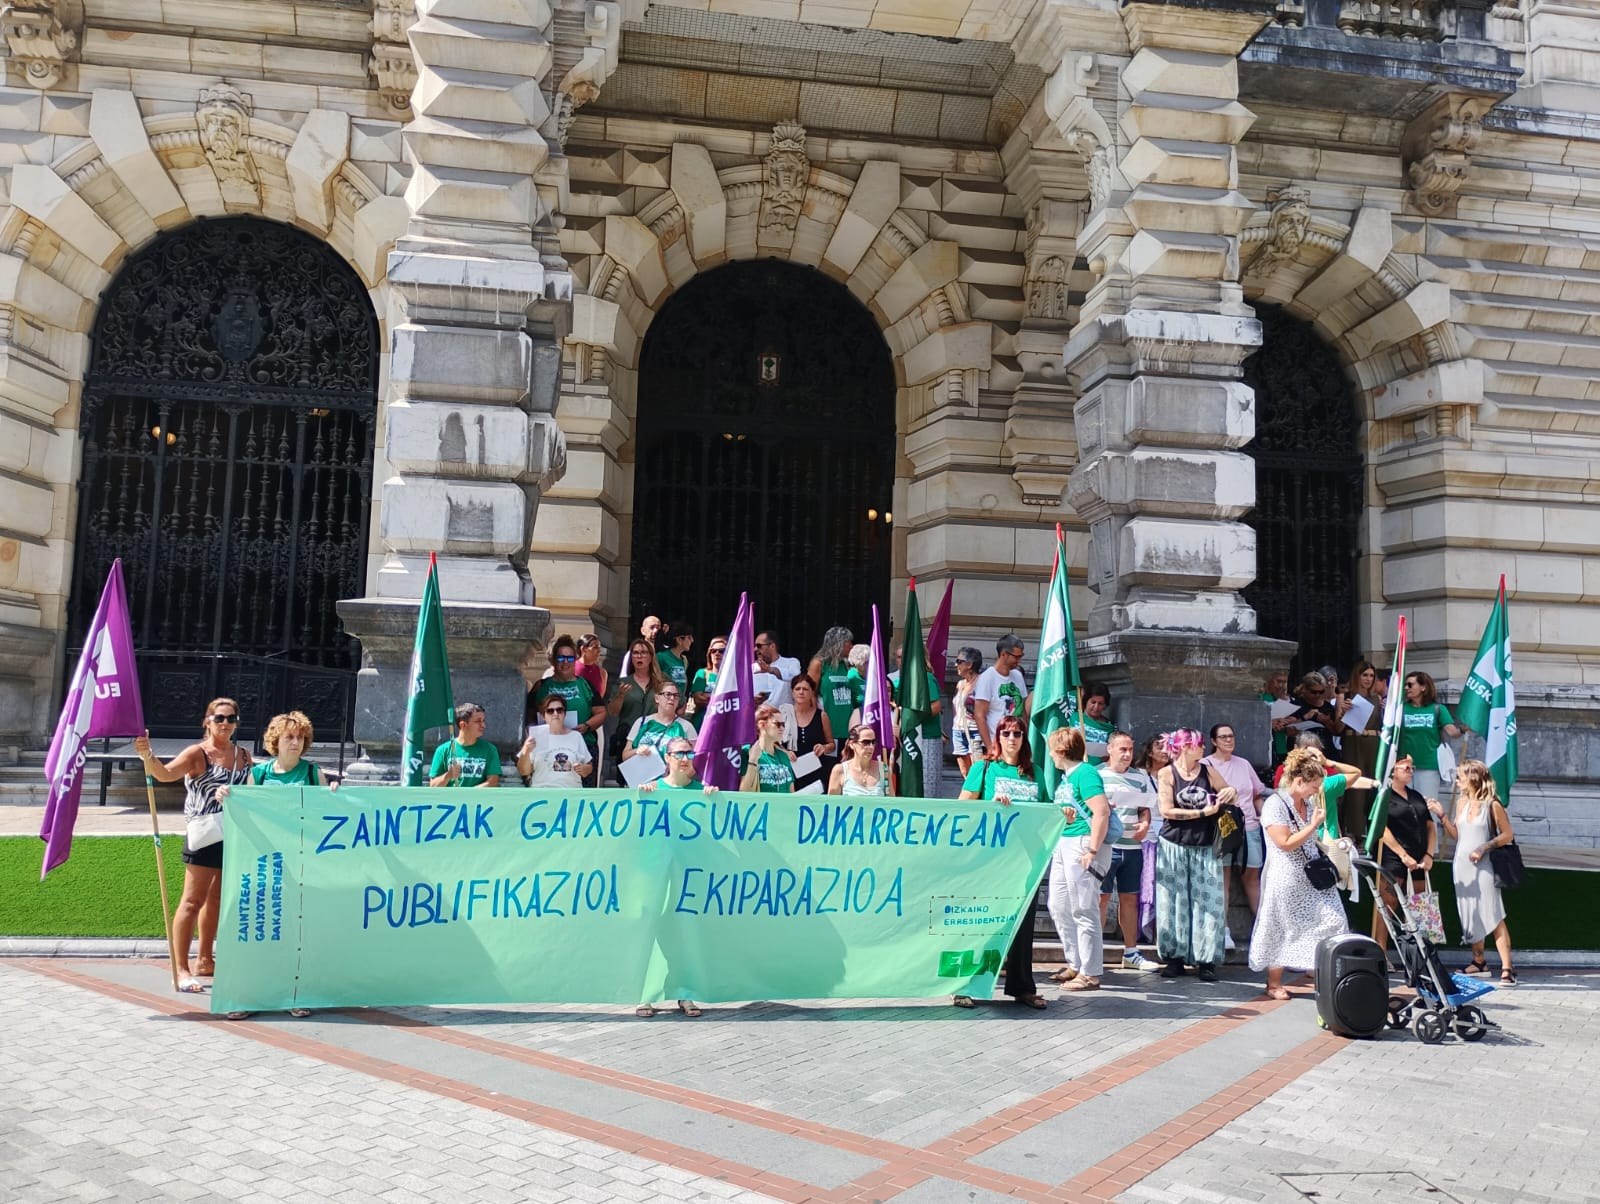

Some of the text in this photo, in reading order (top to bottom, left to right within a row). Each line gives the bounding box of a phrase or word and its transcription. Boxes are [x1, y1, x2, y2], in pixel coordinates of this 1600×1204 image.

[315, 798, 1021, 855] ZAINTZAK GAIXOTASUNA DAKARRENEAN
[238, 872, 251, 942] ZAINTZEAK
[255, 853, 268, 941] GAIXOTASUNA
[271, 851, 283, 941] DAKARRENEAN
[675, 865, 904, 918] EKIPARAZIOA
